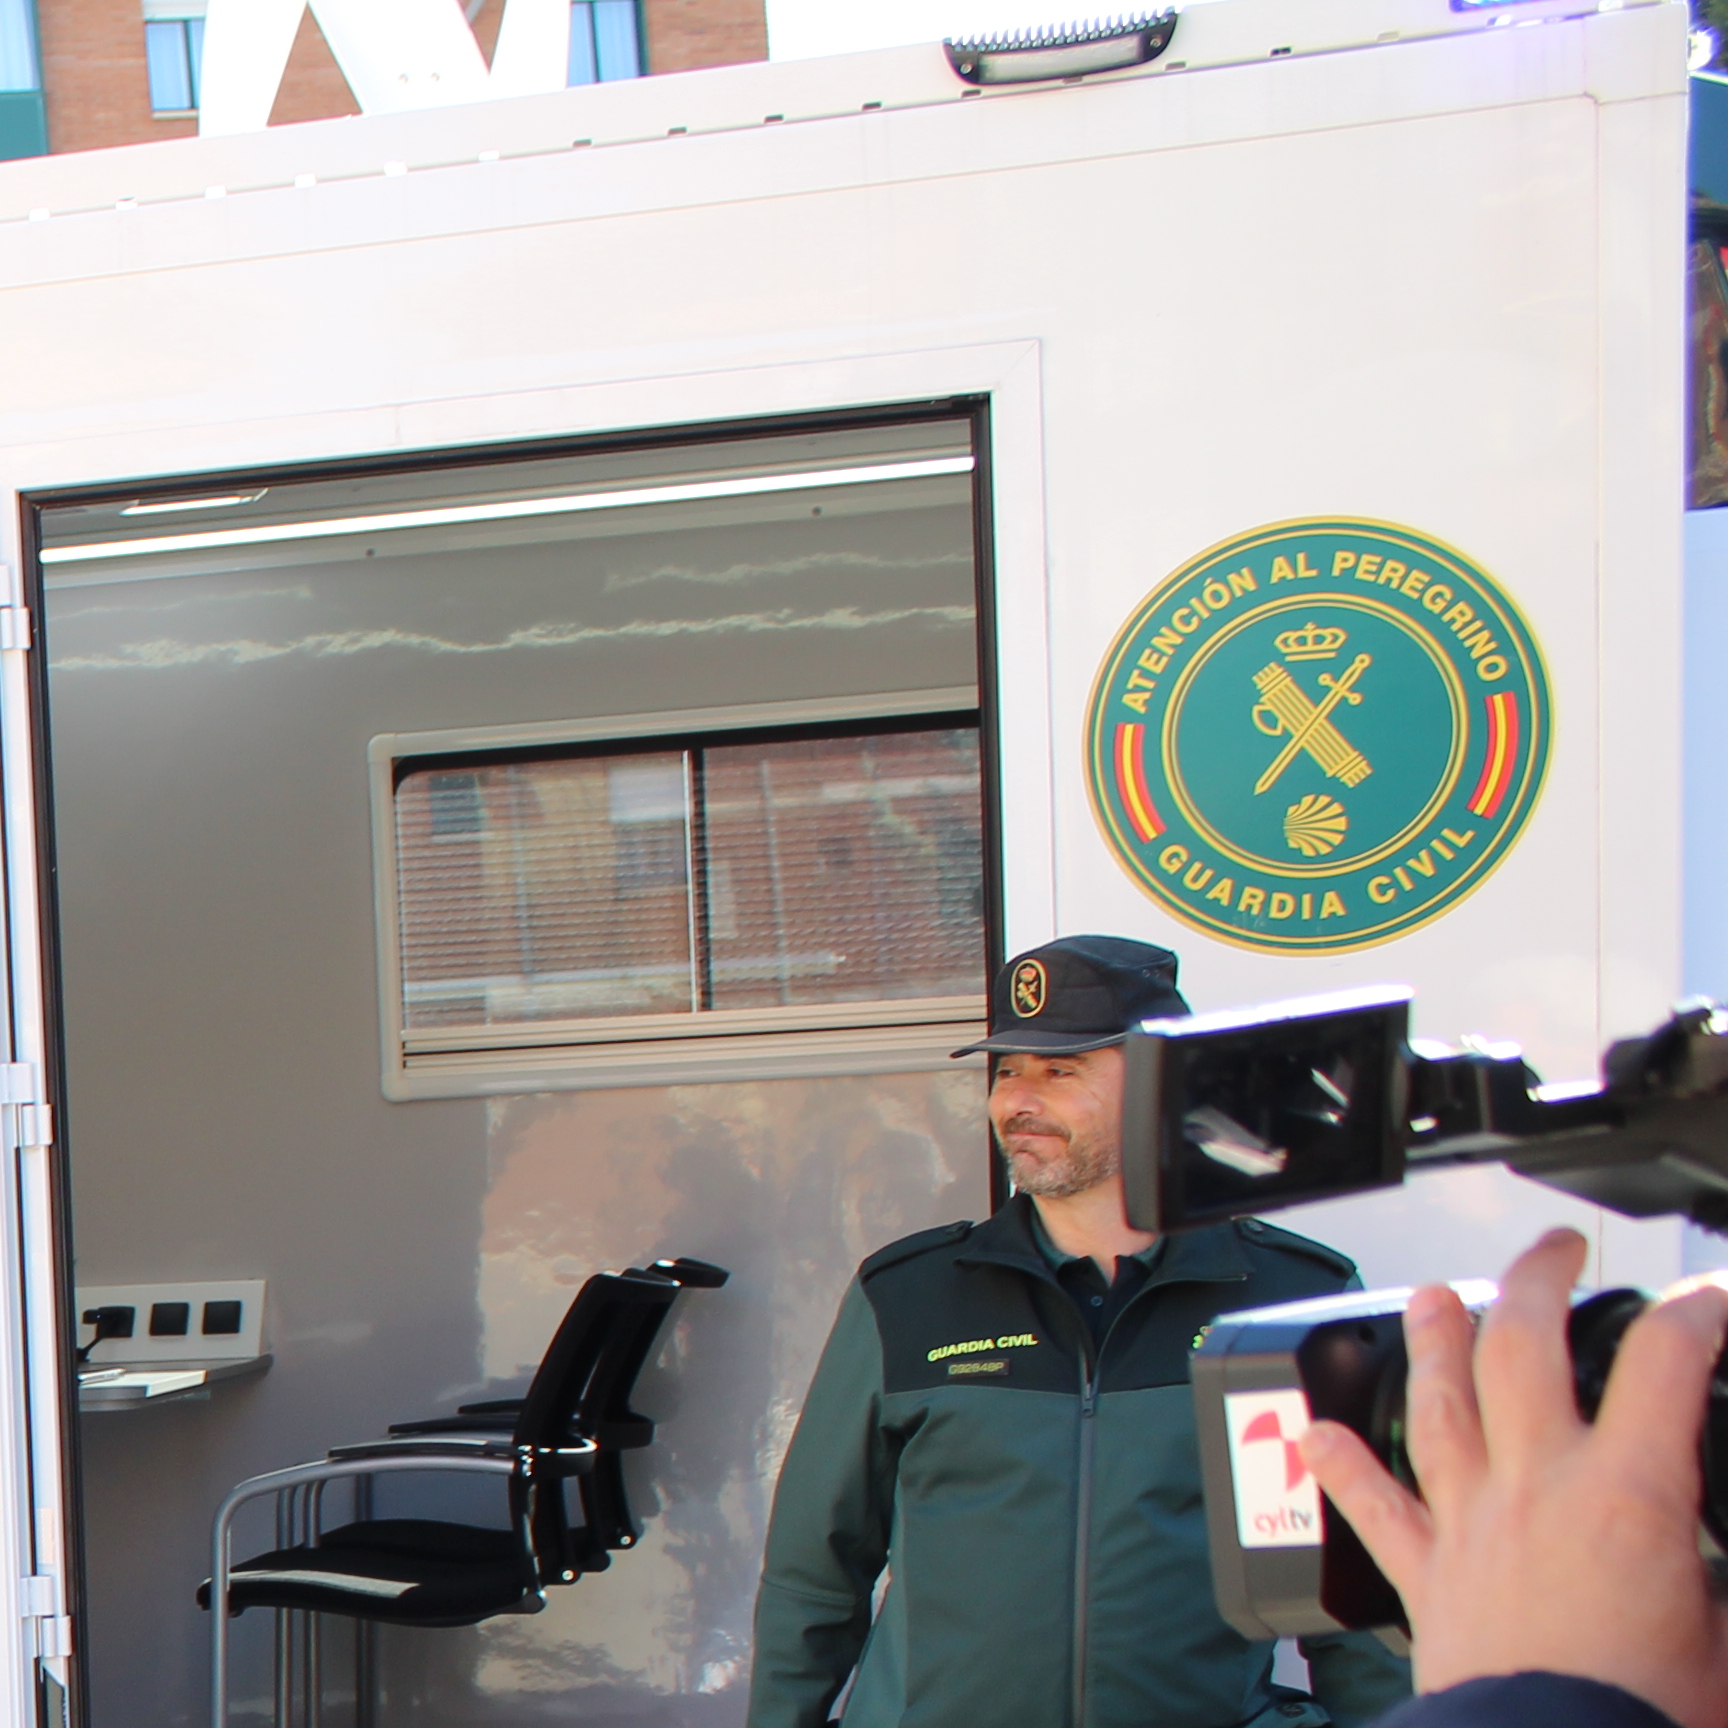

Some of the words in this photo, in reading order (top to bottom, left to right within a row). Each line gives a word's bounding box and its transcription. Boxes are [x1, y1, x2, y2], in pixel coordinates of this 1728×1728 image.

[1121, 568, 1258, 713] ATENCIÓN
[1269, 553, 1318, 585] AL
[1332, 550, 1510, 682] PEREGRINO
[1157, 843, 1346, 920] GUARDIA
[1367, 825, 1476, 904] CIVIL
[927, 1339, 994, 1361] GUARDIA
[997, 1334, 1038, 1348] CIVIL
